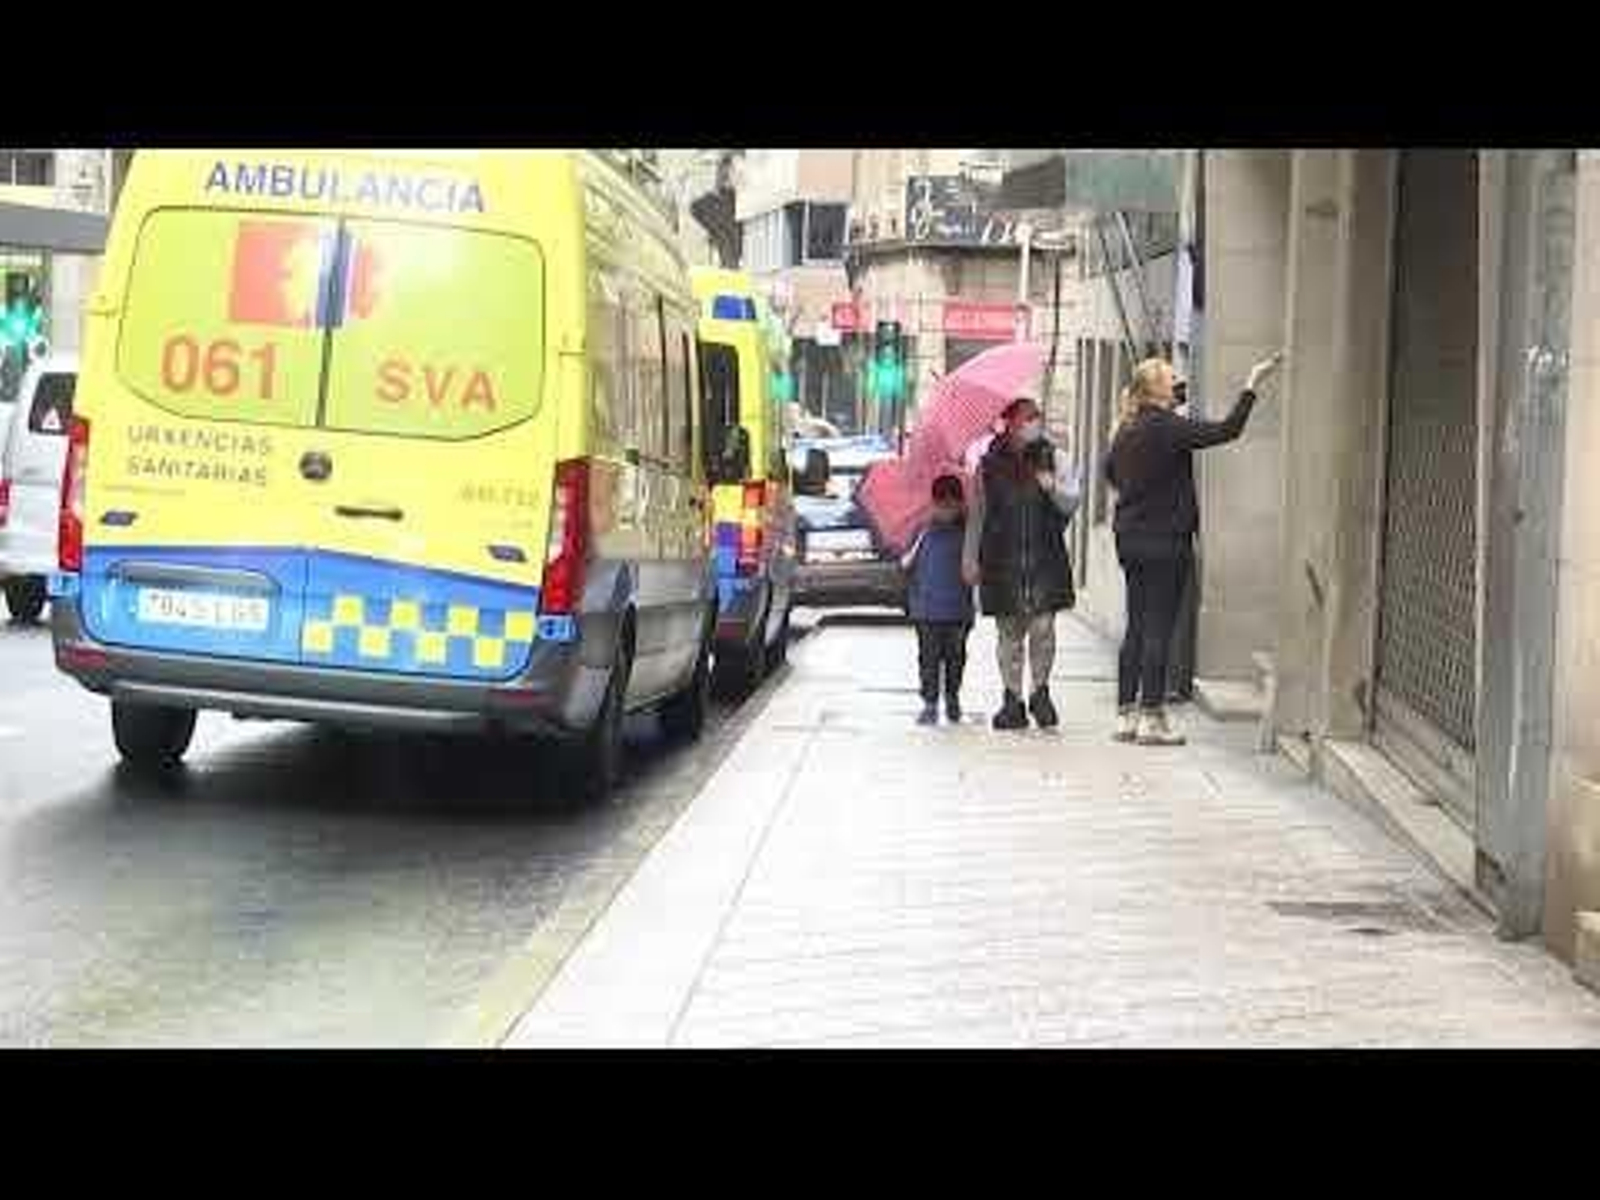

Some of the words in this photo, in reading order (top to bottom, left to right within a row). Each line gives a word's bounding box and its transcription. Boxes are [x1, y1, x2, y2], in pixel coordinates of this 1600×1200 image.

[205, 160, 485, 214] AMBULANCIA
[161, 333, 276, 401] 061
[376, 356, 498, 413] SVA
[127, 455, 269, 488] SANITARIAS
